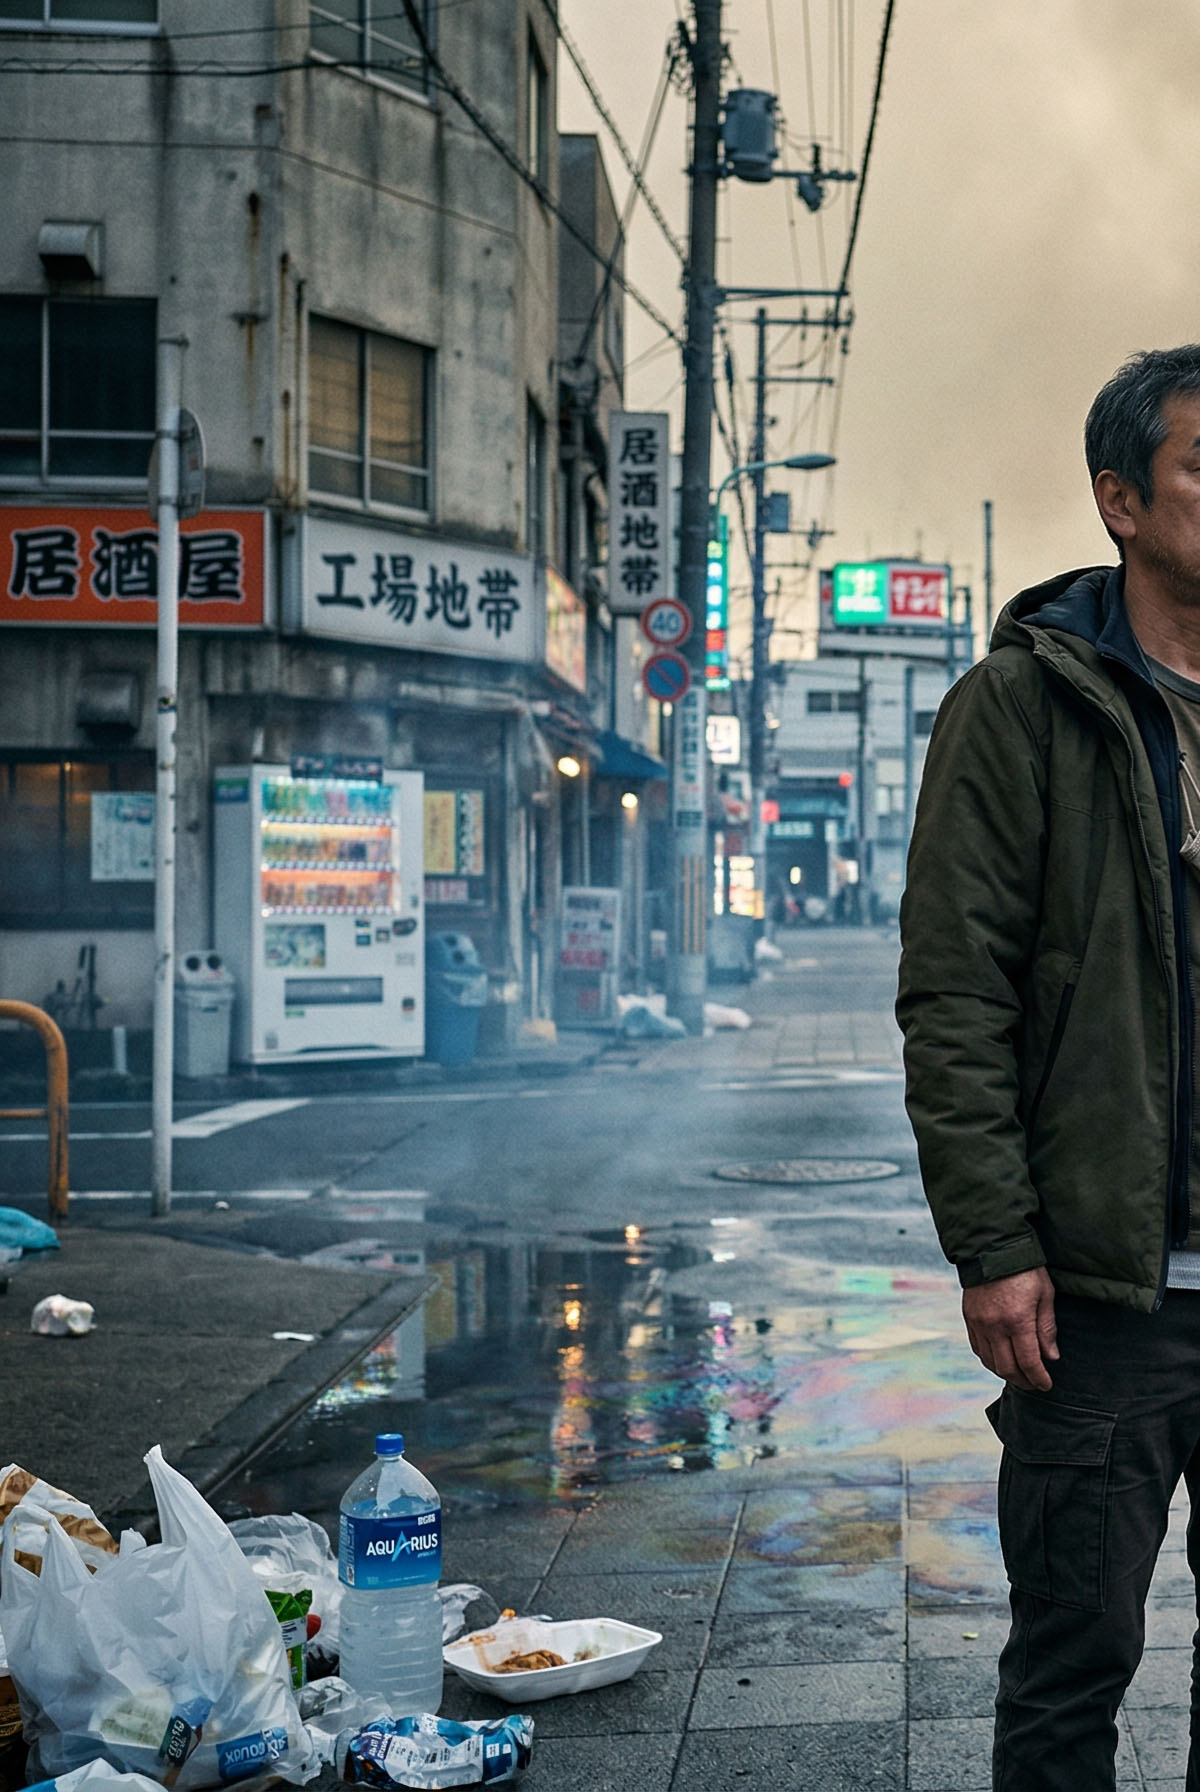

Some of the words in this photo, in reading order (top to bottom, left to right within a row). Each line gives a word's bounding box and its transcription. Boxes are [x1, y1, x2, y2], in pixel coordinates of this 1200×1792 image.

[620, 427, 659, 596] 居酒地帯
[10, 526, 244, 601] 居酒屋
[316, 553, 521, 640] 工場地帯
[651, 611, 681, 633] 40
[366, 1530, 439, 1562] AQUARIUS
